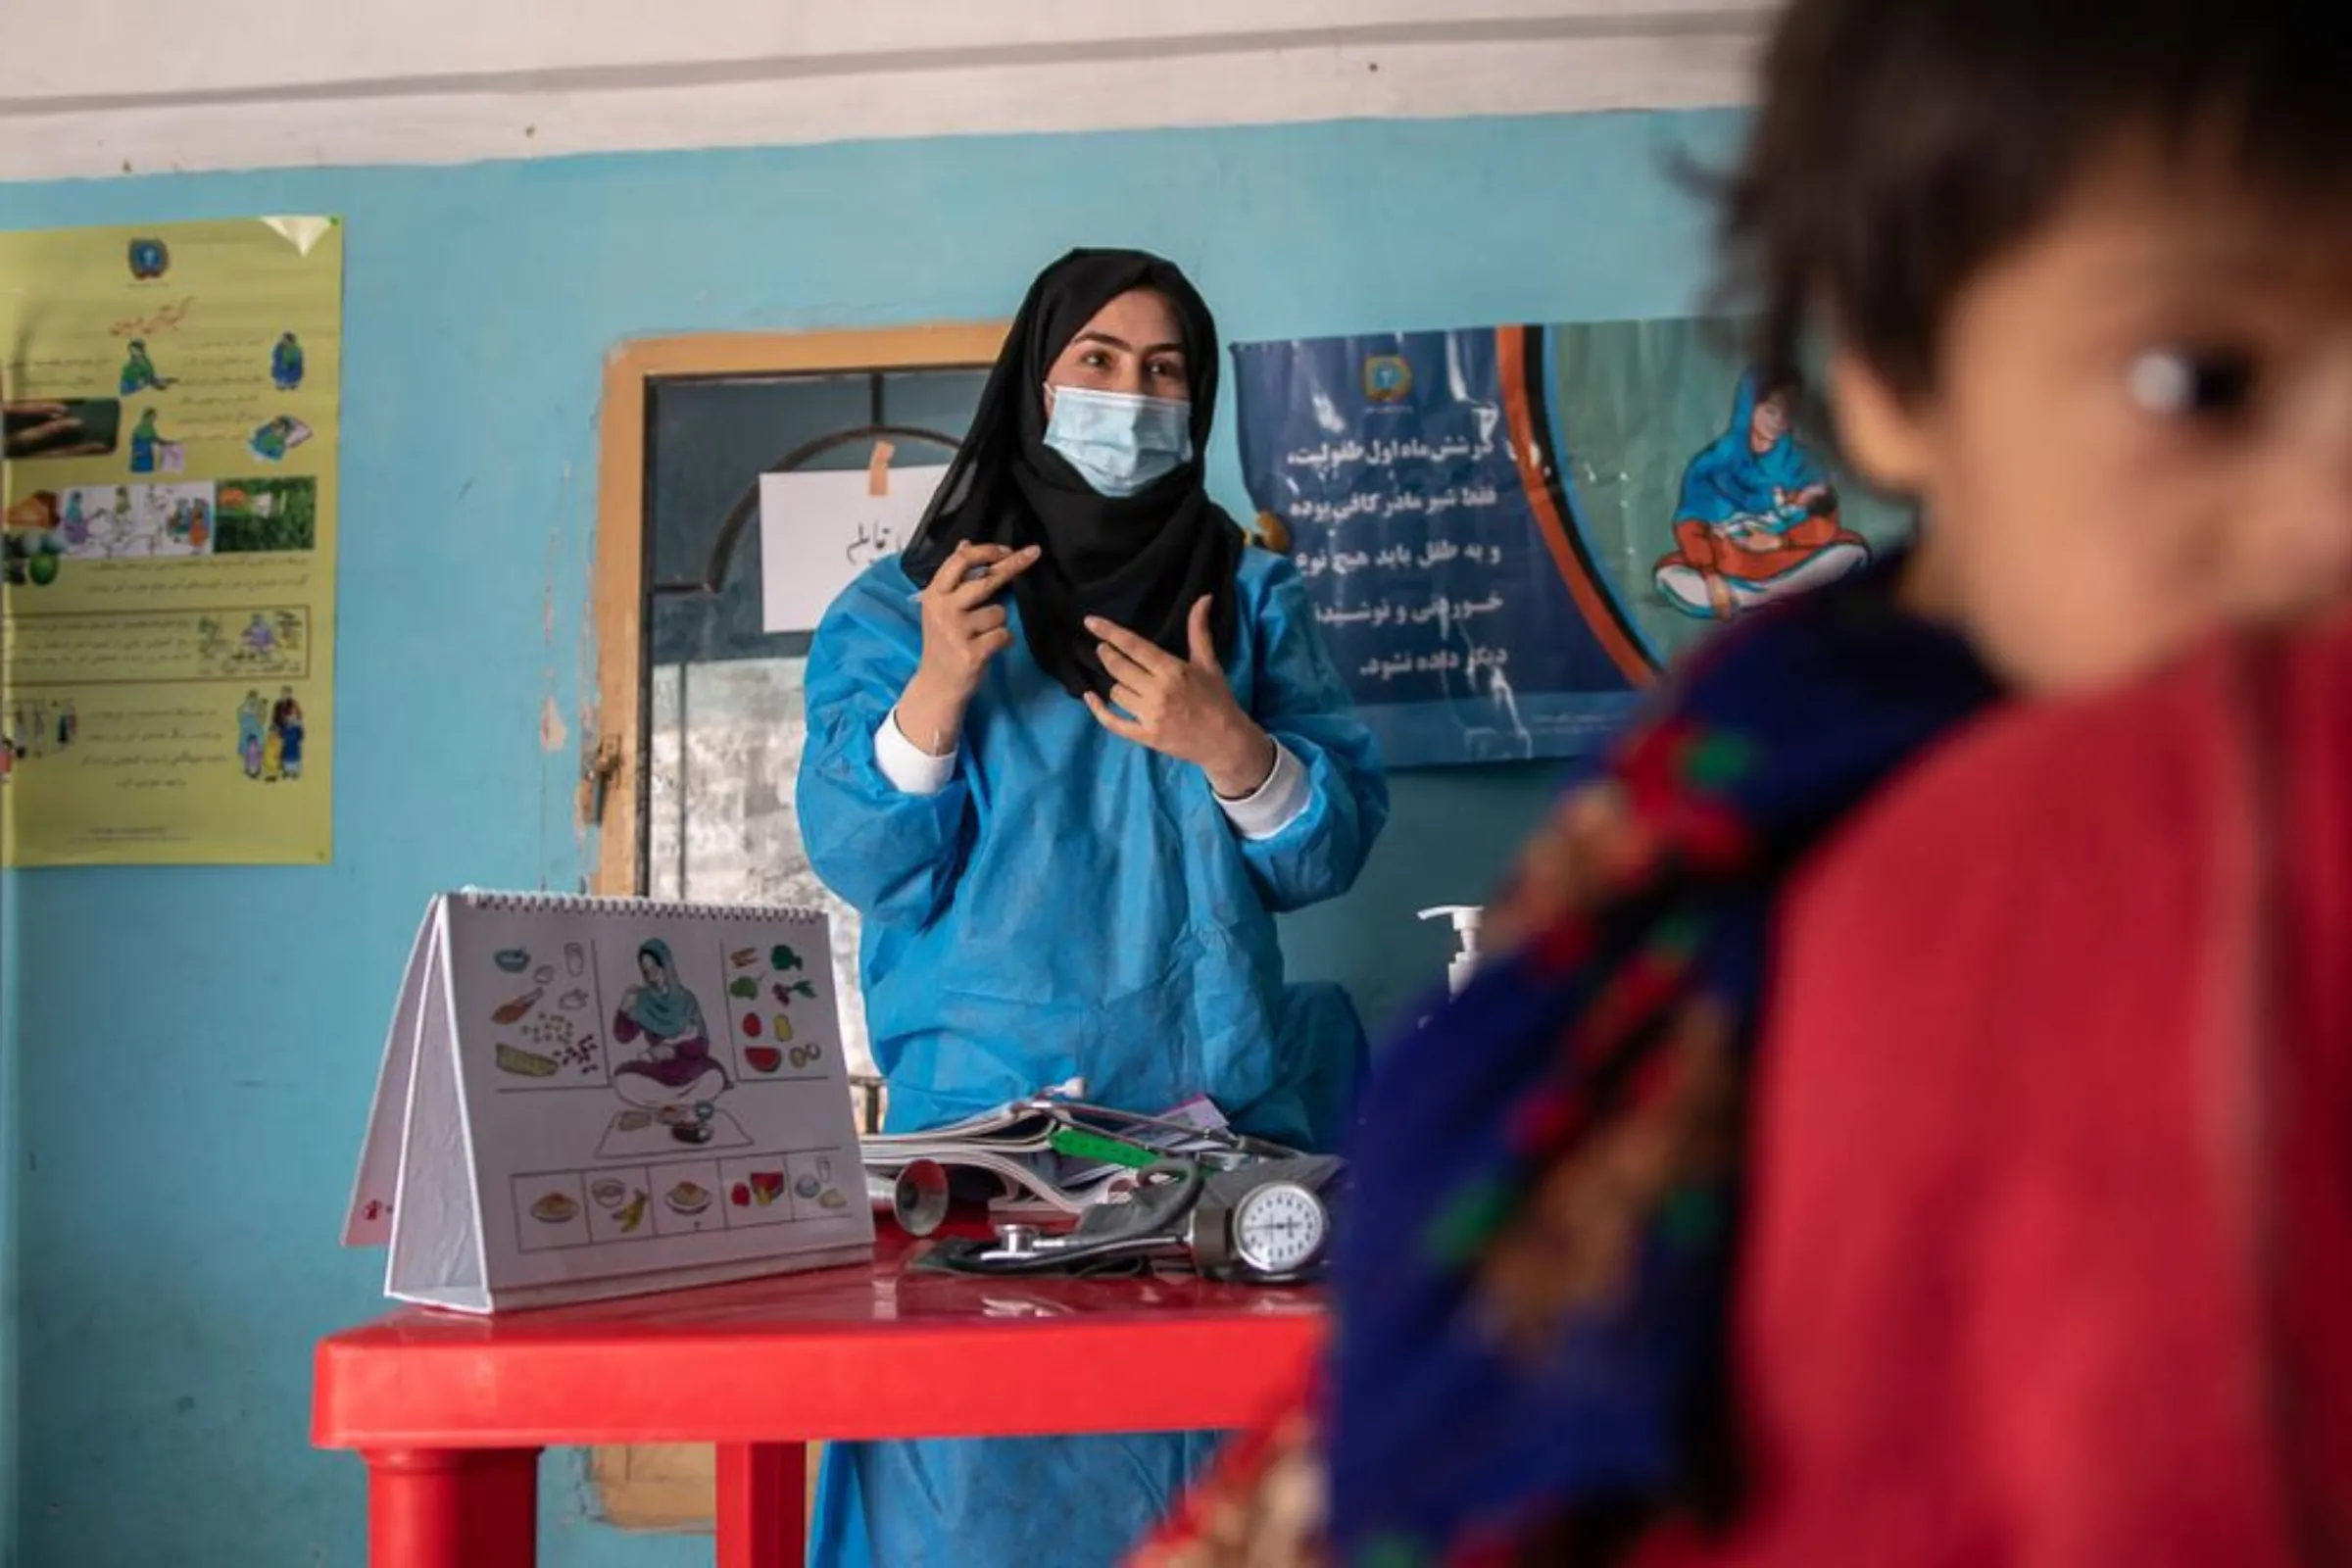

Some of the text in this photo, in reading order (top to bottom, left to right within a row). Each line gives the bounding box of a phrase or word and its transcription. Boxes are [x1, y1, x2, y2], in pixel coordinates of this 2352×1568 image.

[1366, 438, 1397, 465] اول
[1401, 437, 1429, 458] ماه
[1430, 434, 1469, 462] شش
[1382, 491, 1423, 517] مادر
[1425, 488, 1457, 515] شیر
[1461, 485, 1497, 507] فقط
[1332, 551, 1369, 574] هیچ
[1375, 543, 1412, 568] باید
[1417, 540, 1458, 567] طفل
[1463, 544, 1483, 564] به
[1490, 545, 1501, 564] و
[1396, 605, 1407, 624] و
[1417, 650, 1460, 671] داده
